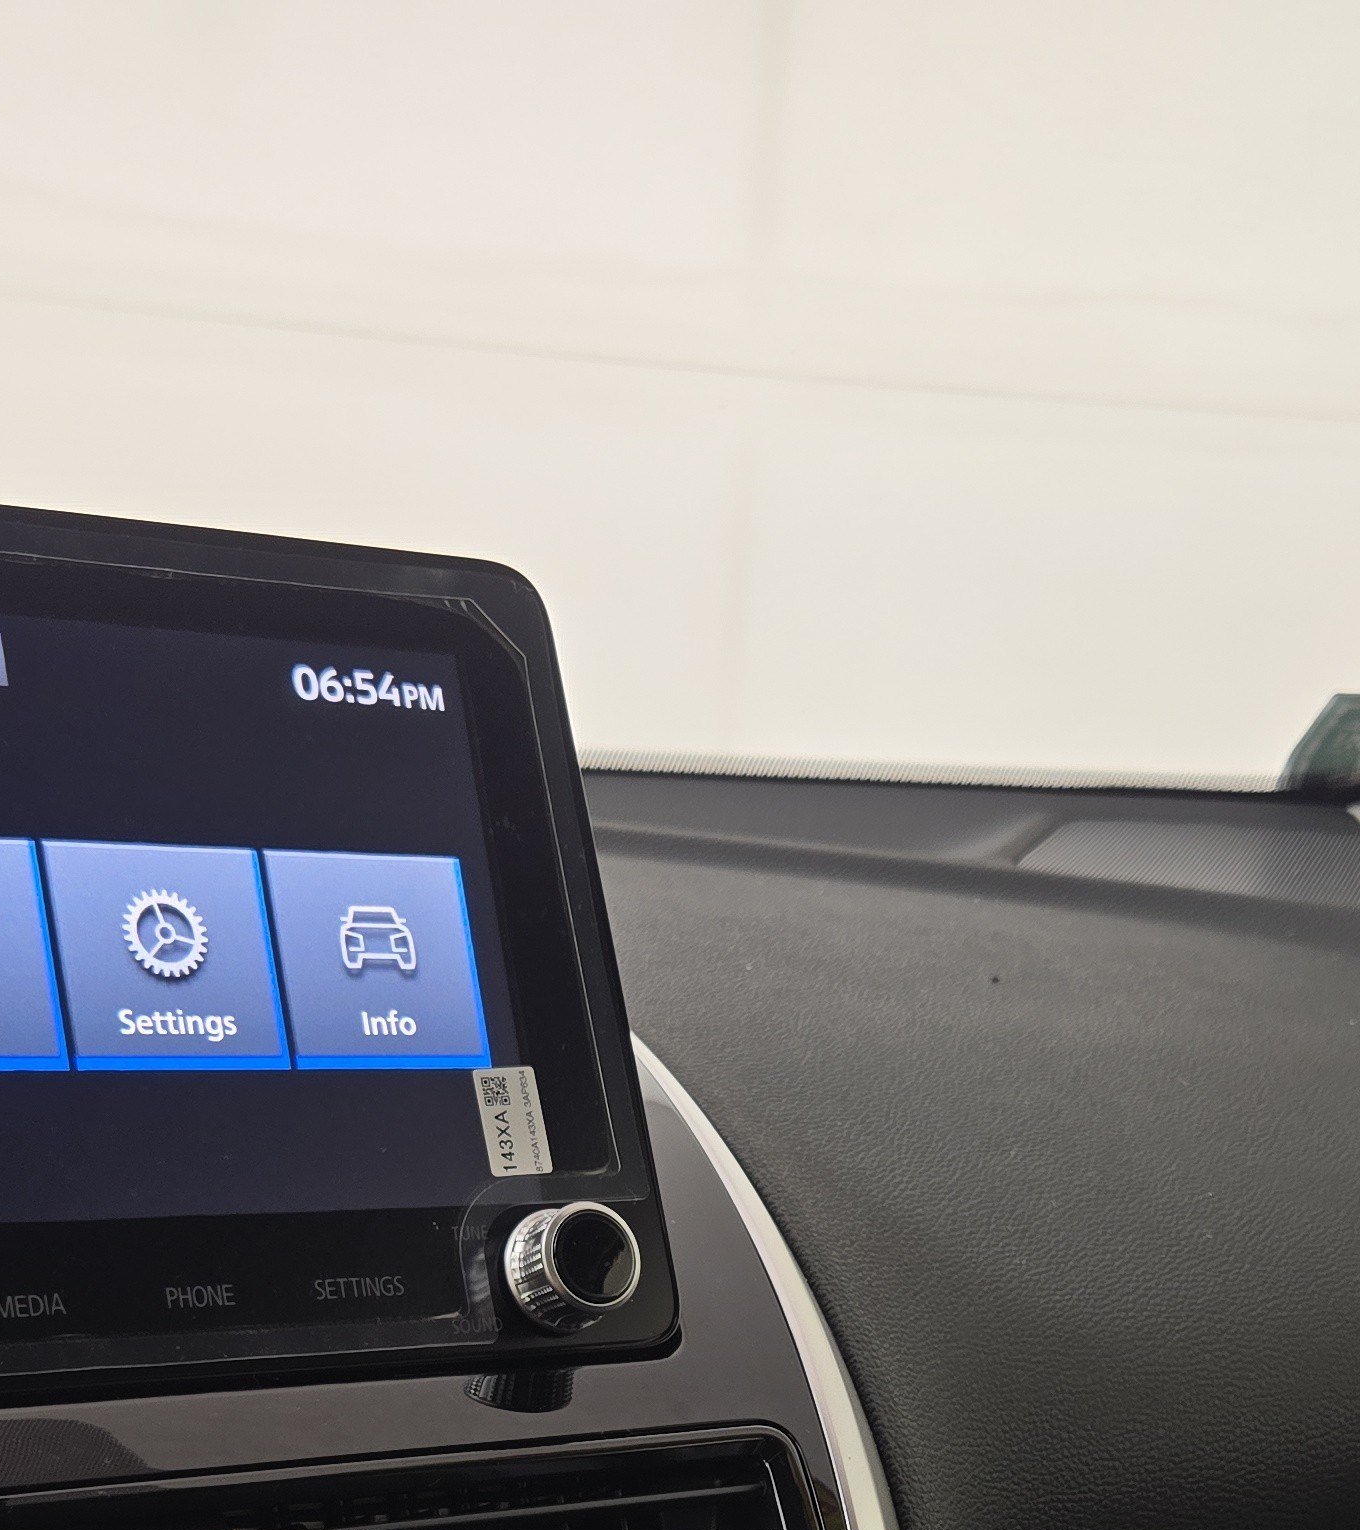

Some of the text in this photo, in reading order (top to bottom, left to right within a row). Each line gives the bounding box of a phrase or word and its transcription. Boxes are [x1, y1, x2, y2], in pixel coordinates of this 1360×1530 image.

[116, 1006, 238, 1044] Settings
[360, 1008, 418, 1038] Info
[494, 1110, 517, 1170] 143XA
[165, 1282, 237, 1310] PHONE
[313, 1272, 406, 1301] SETTINGS
